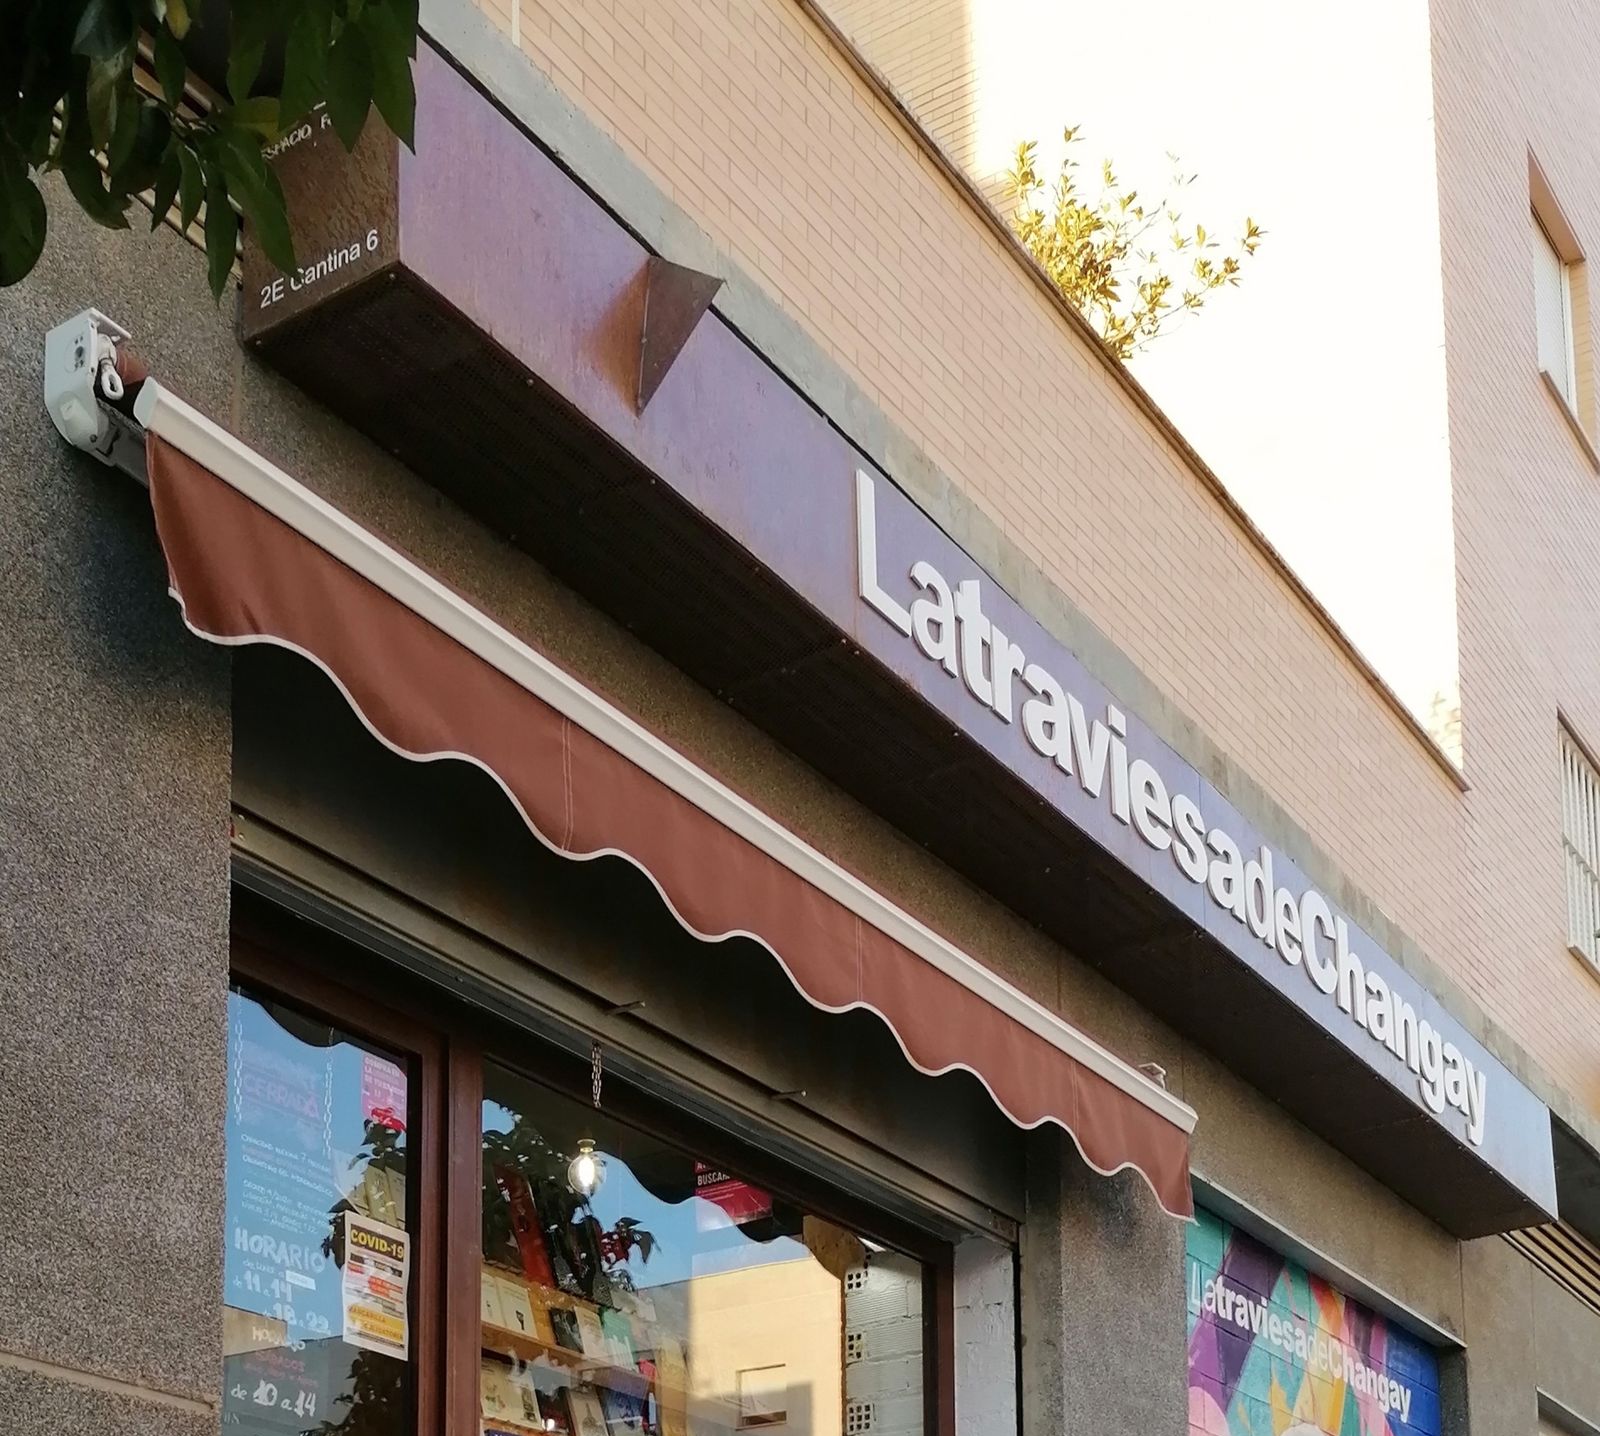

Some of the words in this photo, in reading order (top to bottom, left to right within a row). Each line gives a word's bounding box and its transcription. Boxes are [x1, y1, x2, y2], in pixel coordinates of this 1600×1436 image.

[260, 278, 285, 309] 2E
[290, 241, 361, 292] Cantina
[366, 229, 379, 251] 6
[856, 468, 1487, 1147] LatraviesadeChangay
[234, 1227, 325, 1274] HORARIO
[351, 1229, 404, 1259] COVID-19
[1192, 1262, 1412, 1424] LatraviesadeChangay
[231, 1384, 248, 1401] de
[280, 1399, 293, 1411] a
